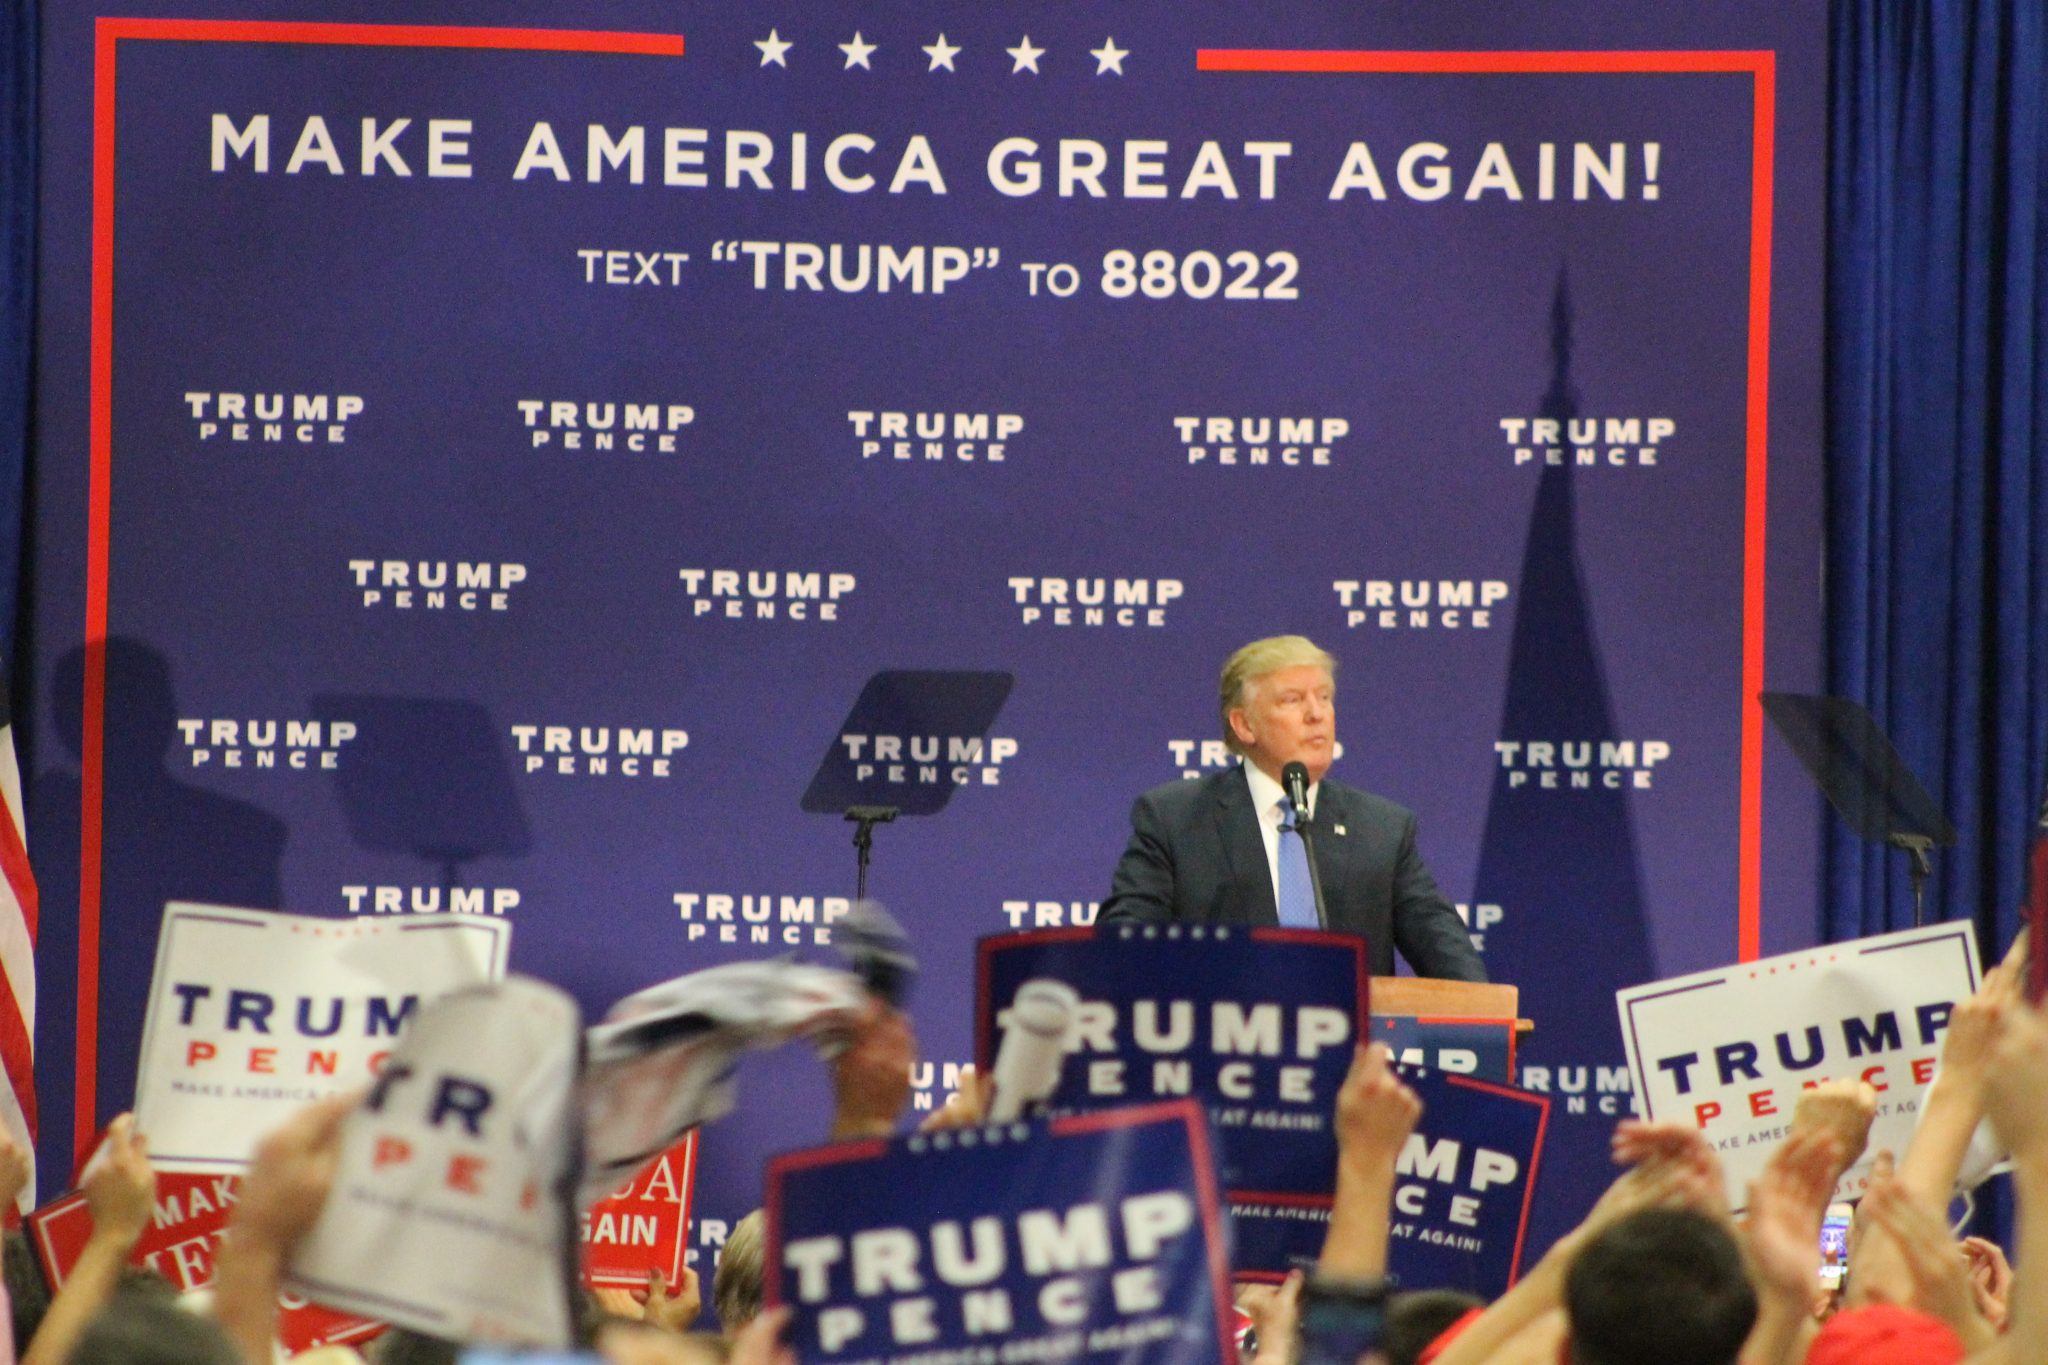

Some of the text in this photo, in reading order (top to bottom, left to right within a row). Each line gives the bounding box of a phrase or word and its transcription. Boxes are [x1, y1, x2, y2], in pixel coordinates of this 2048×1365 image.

[210, 113, 1660, 202] MAKE AMERICA GREAT AGAIN!
[577, 240, 1299, 301] TEXT “TRUMP” TO 88022
[184, 392, 364, 425] TRUMP
[517, 400, 695, 434] TRUMP
[199, 423, 346, 443] PENCE
[532, 432, 676, 453] PENCE
[847, 411, 1024, 444] TRUMP
[1173, 417, 1349, 450] TRUMP
[1499, 418, 1675, 451] TRUMP
[862, 443, 1005, 462] PENCE
[1188, 448, 1331, 467] PENCE
[1514, 449, 1656, 467] PENCE
[348, 560, 527, 594] TRUMP
[679, 569, 856, 603] TRUMP
[363, 592, 508, 612] PENCE
[694, 600, 838, 622] PENCE
[1008, 577, 1184, 612] TRUMP
[1333, 580, 1508, 613] TRUMP
[1022, 609, 1165, 628] PENCE
[1347, 611, 1490, 630] PENCE
[177, 719, 357, 752] TRUMP
[511, 725, 689, 759] TRUMP
[842, 735, 1019, 768] TRUMP
[192, 748, 338, 769] PENCE
[526, 757, 670, 778] PENCE
[1494, 740, 1671, 773] TRUMP
[857, 766, 1000, 786] PENCE
[1509, 771, 1652, 790] PENCE
[342, 886, 520, 915] TRUMP
[673, 893, 850, 924] TRUMP
[1003, 901, 1099, 928] TRU
[688, 923, 832, 945] PENCE
[173, 984, 418, 1037] TRUM
[997, 999, 1351, 1061] RUMP
[1087, 1059, 1316, 1104] ENCE
[1522, 1066, 1632, 1093] RUM
[152, 1173, 242, 1230] MAK
[783, 1190, 1194, 1304] TRUMP
[1418, 1227, 1483, 1254] AGAIN!
[817, 1264, 1169, 1354] PENCE
